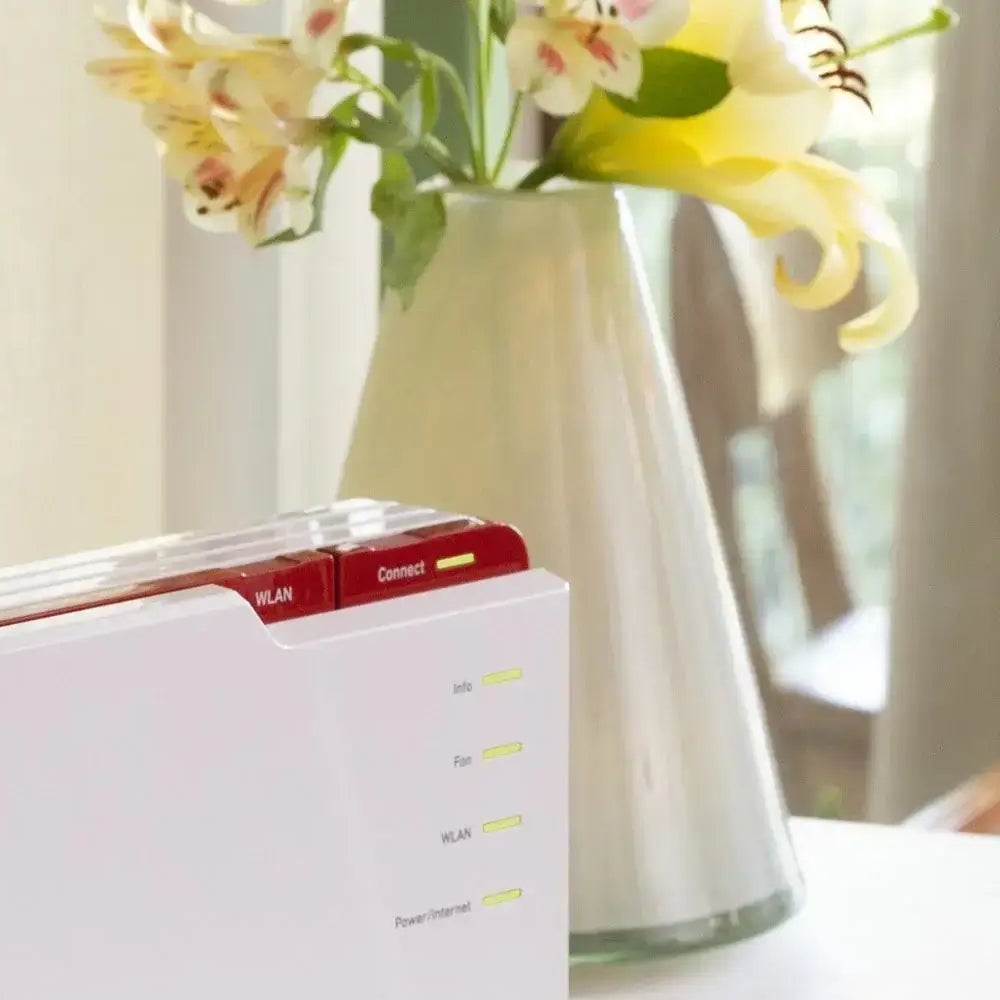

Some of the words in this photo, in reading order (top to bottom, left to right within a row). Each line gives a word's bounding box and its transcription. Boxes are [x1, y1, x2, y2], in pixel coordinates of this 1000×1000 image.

[377, 560, 425, 583] Connect
[255, 587, 293, 606] WLAN
[453, 681, 472, 694] Info
[453, 755, 472, 768] Fan
[441, 828, 471, 844] WLAN
[394, 901, 471, 928] Power/Internet
